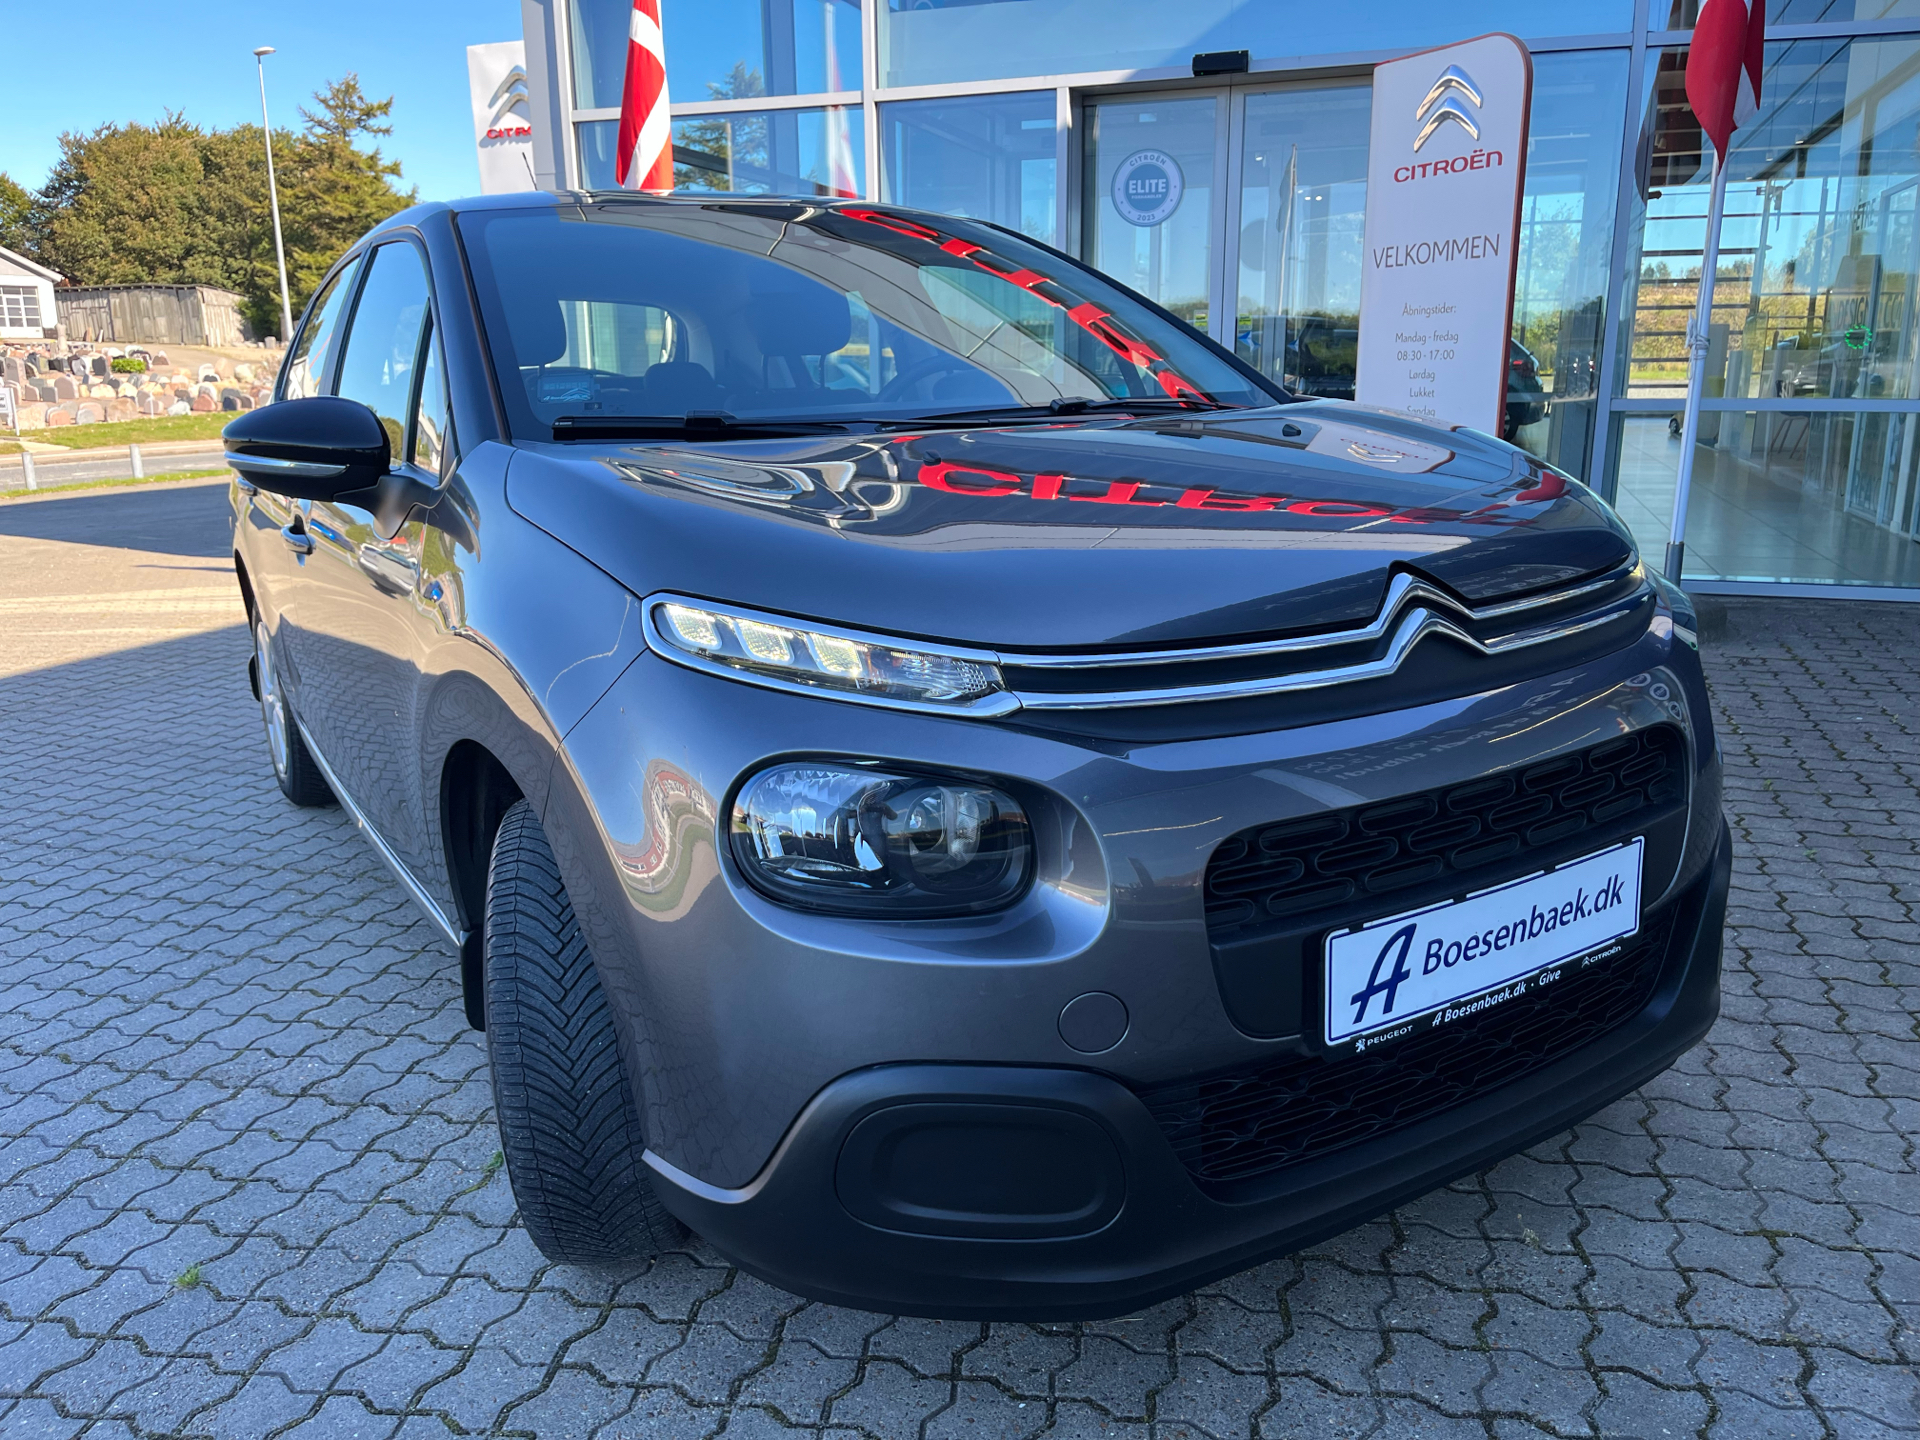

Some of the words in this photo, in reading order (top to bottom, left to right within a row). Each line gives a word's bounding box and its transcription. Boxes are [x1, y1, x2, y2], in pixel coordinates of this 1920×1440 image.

[1129, 179, 1167, 194] ELITE
[1137, 213, 1156, 221] 2023
[1373, 234, 1500, 269] VELKOMMEN
[1402, 302, 1457, 318] Åbningstider:
[1395, 332, 1427, 345] Mandag
[1433, 330, 1459, 344] fredag
[1396, 350, 1422, 361] 08:30
[1429, 349, 1455, 360] 17:00
[1409, 369, 1436, 382] Lørdag
[1409, 387, 1435, 398] Lukket
[1422, 873, 1625, 976] Boesenbaek.dk
[1444, 981, 1527, 1022] Boesenbaek.dk
[1539, 969, 1561, 985] Give
[1367, 1025, 1413, 1046] PEUGEOT
